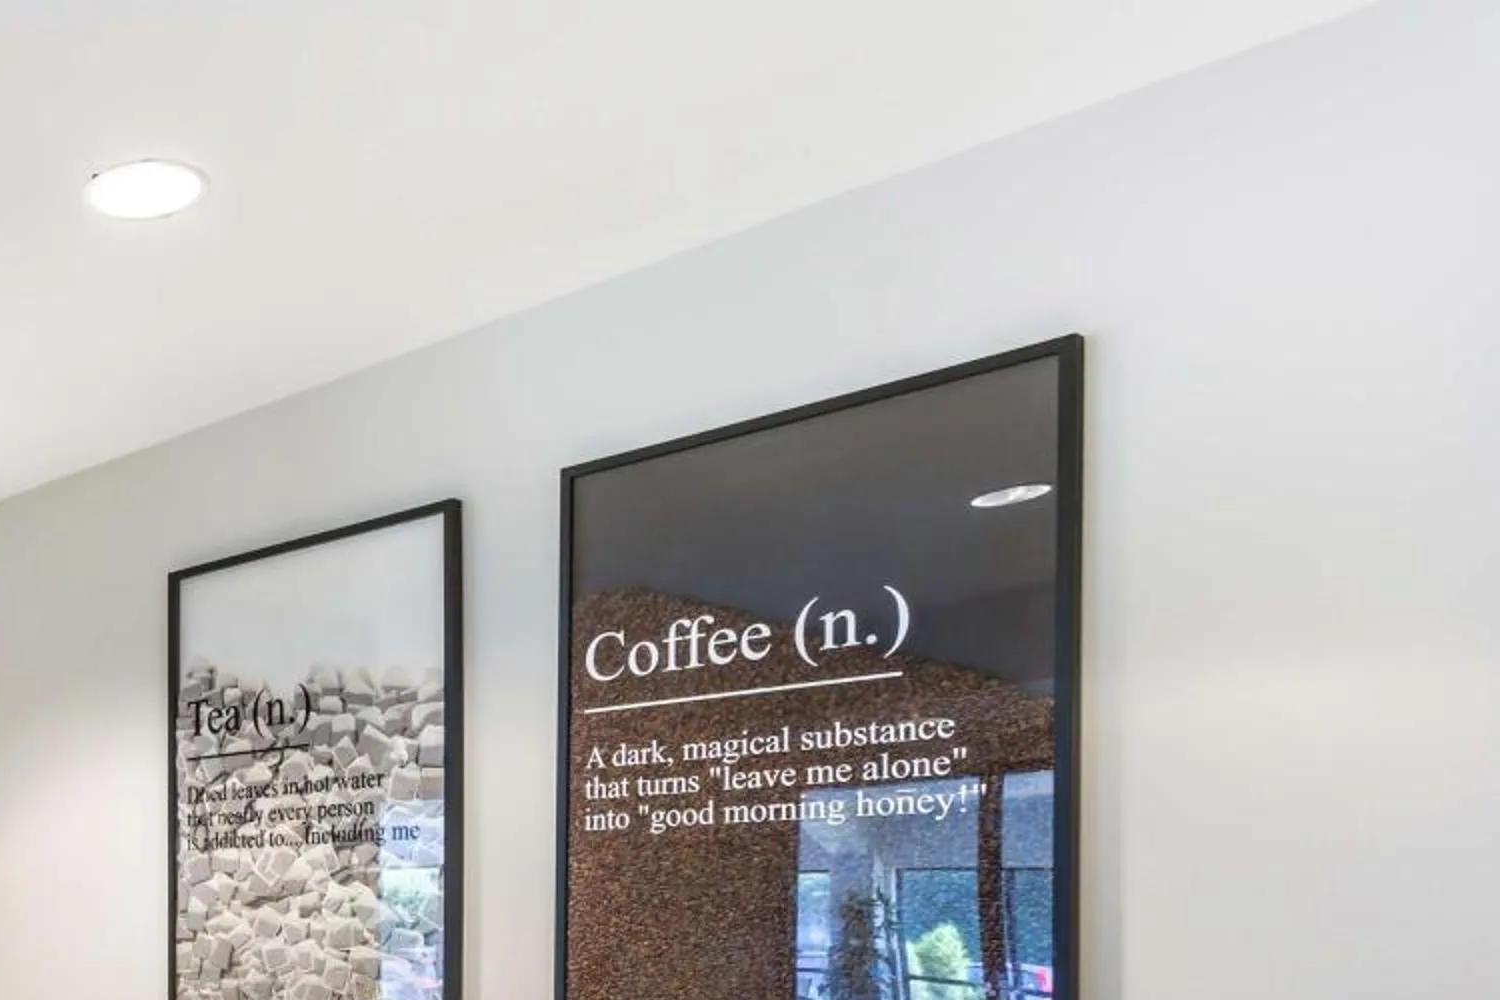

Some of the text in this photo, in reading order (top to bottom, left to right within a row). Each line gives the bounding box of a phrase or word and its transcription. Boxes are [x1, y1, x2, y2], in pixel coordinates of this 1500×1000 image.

[585, 585, 910, 681] Coffee (n.)
[187, 683, 312, 737] Tea (n.)
[587, 718, 955, 769] A dark, magical substance
[232, 781, 278, 800] leaves
[282, 779, 299, 795] in
[304, 775, 331, 793] hot
[334, 772, 385, 790] water
[585, 748, 967, 800] that turns "leave me alone"
[268, 805, 312, 824] every
[317, 800, 375, 823] person
[305, 822, 386, 847] Including
[392, 823, 421, 842] me
[585, 785, 987, 834] into "good morning honey!"
